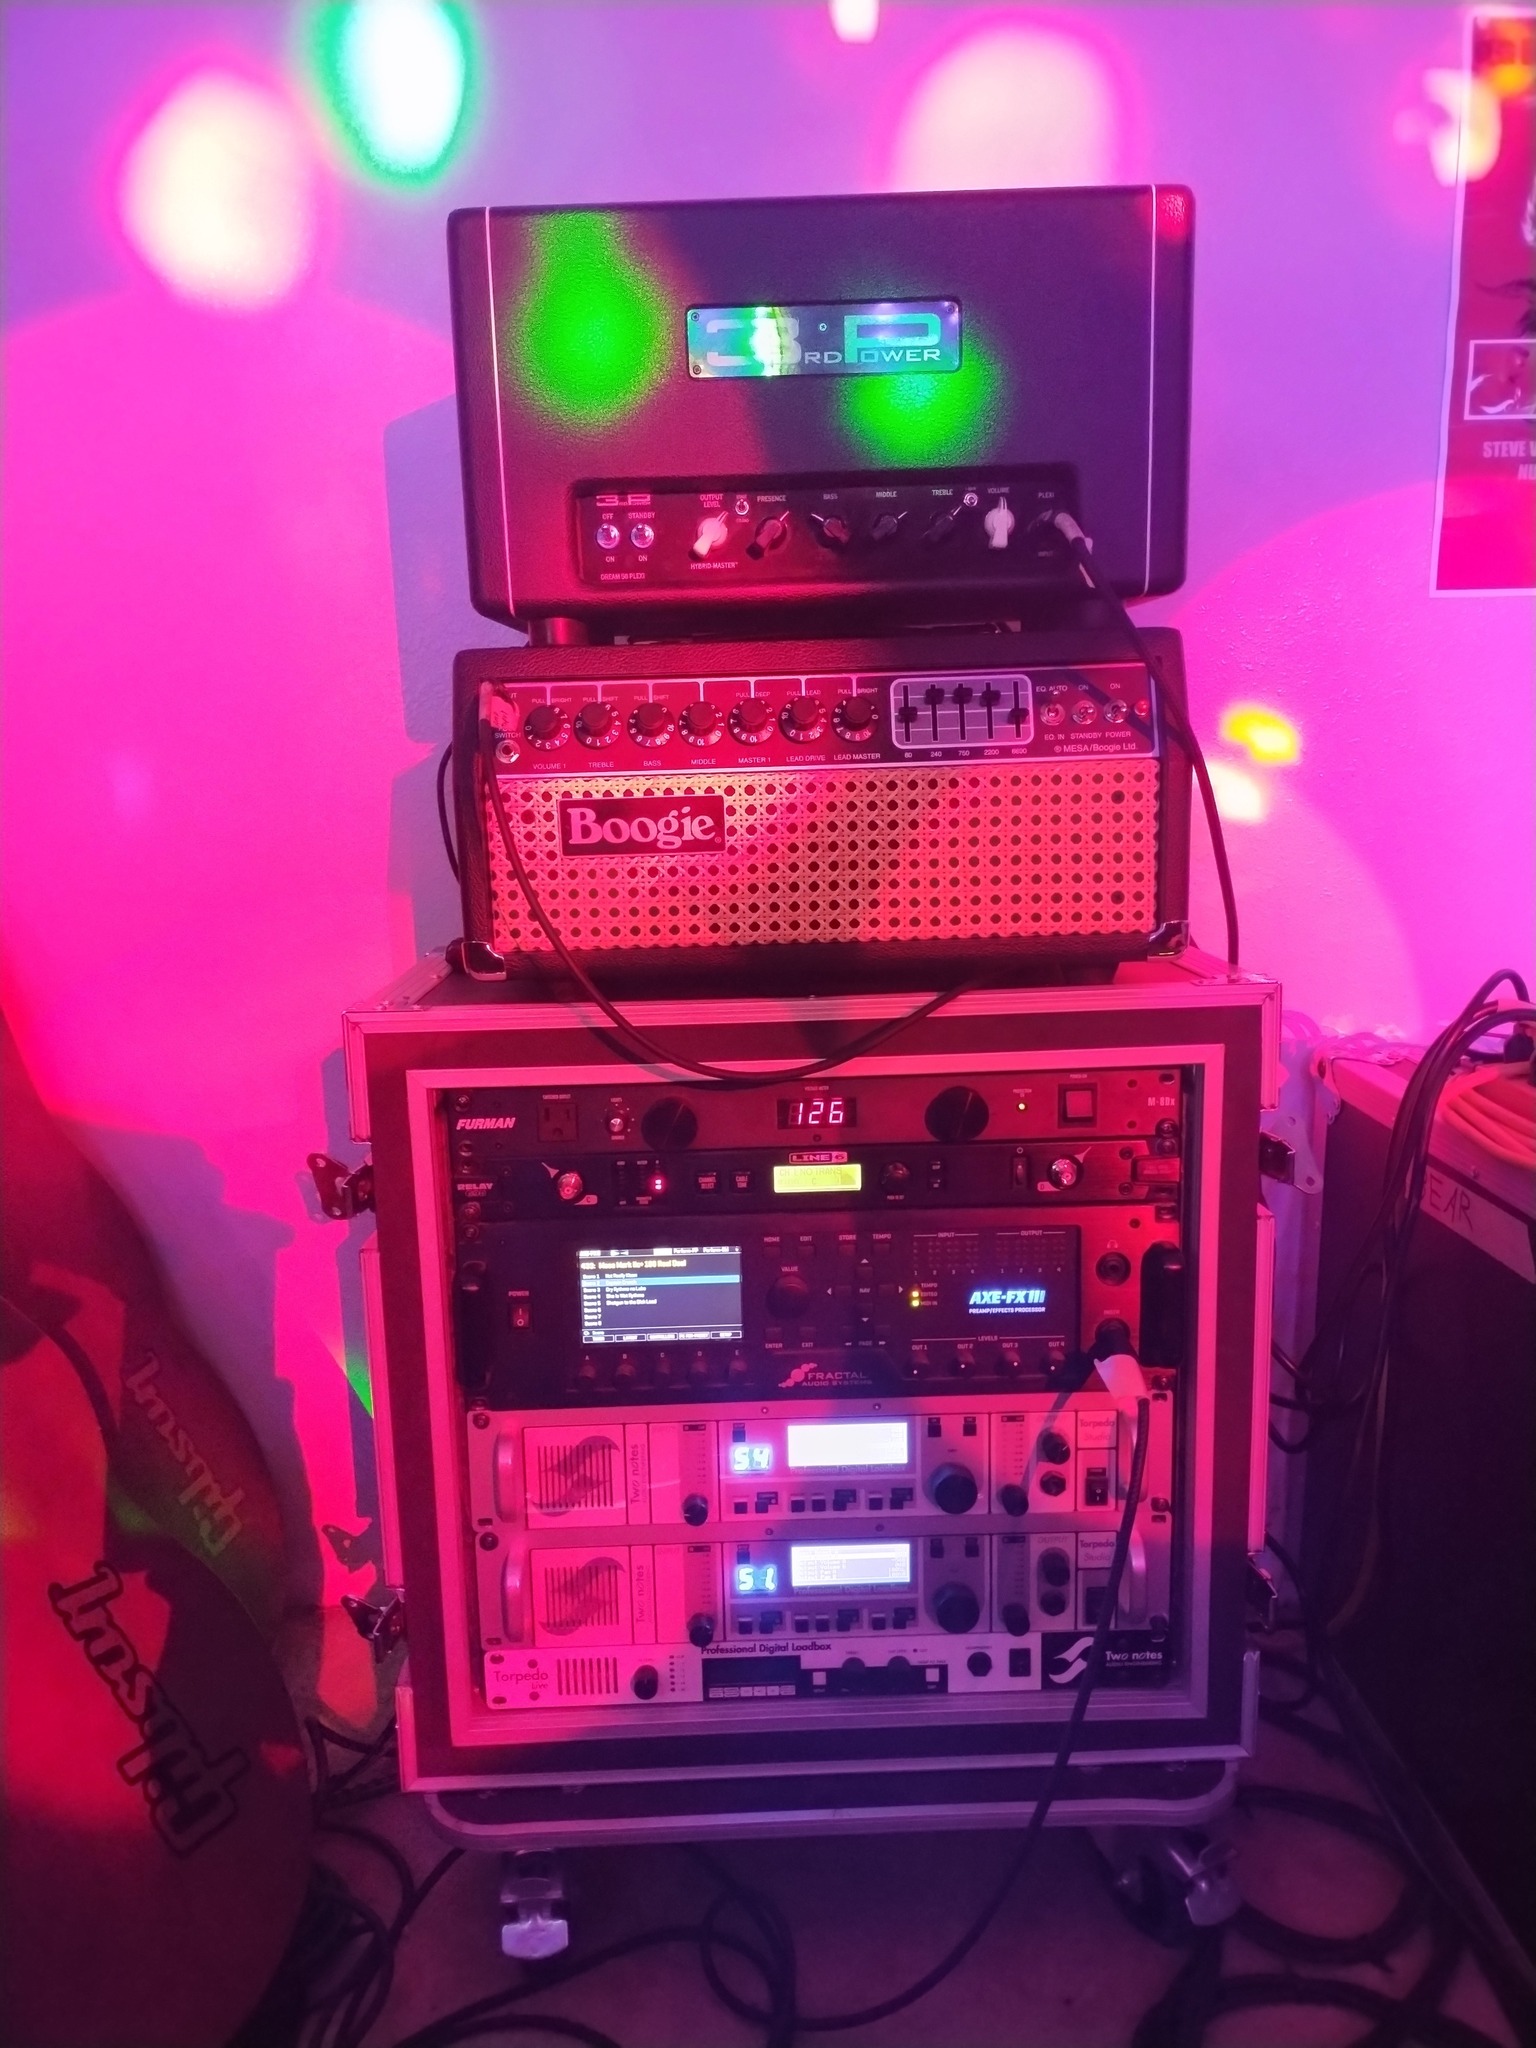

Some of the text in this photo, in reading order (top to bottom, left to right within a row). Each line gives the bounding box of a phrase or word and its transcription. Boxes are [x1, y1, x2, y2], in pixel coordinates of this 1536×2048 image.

[1482, 441, 1527, 458] STEVE
[987, 486, 1010, 494] VOLUME
[628, 511, 656, 519] STANDBY
[1063, 743, 1121, 753] MESA/Boogie
[566, 806, 717, 849] Boogie
[798, 1101, 844, 1125] 126
[456, 1117, 516, 1130] FURMAN
[791, 1154, 831, 1162] LINE
[969, 1291, 1028, 1305] AXE-FX
[808, 1372, 868, 1380] FRACTAL
[1079, 1418, 1116, 1428] Torpedo
[630, 1443, 640, 1476] notes
[1079, 1539, 1115, 1549] Torpedo
[701, 1640, 832, 1655] Professional Digital Loadbox
[1105, 1650, 1163, 1661] Two notes
[493, 1668, 549, 1683] Torpedo
